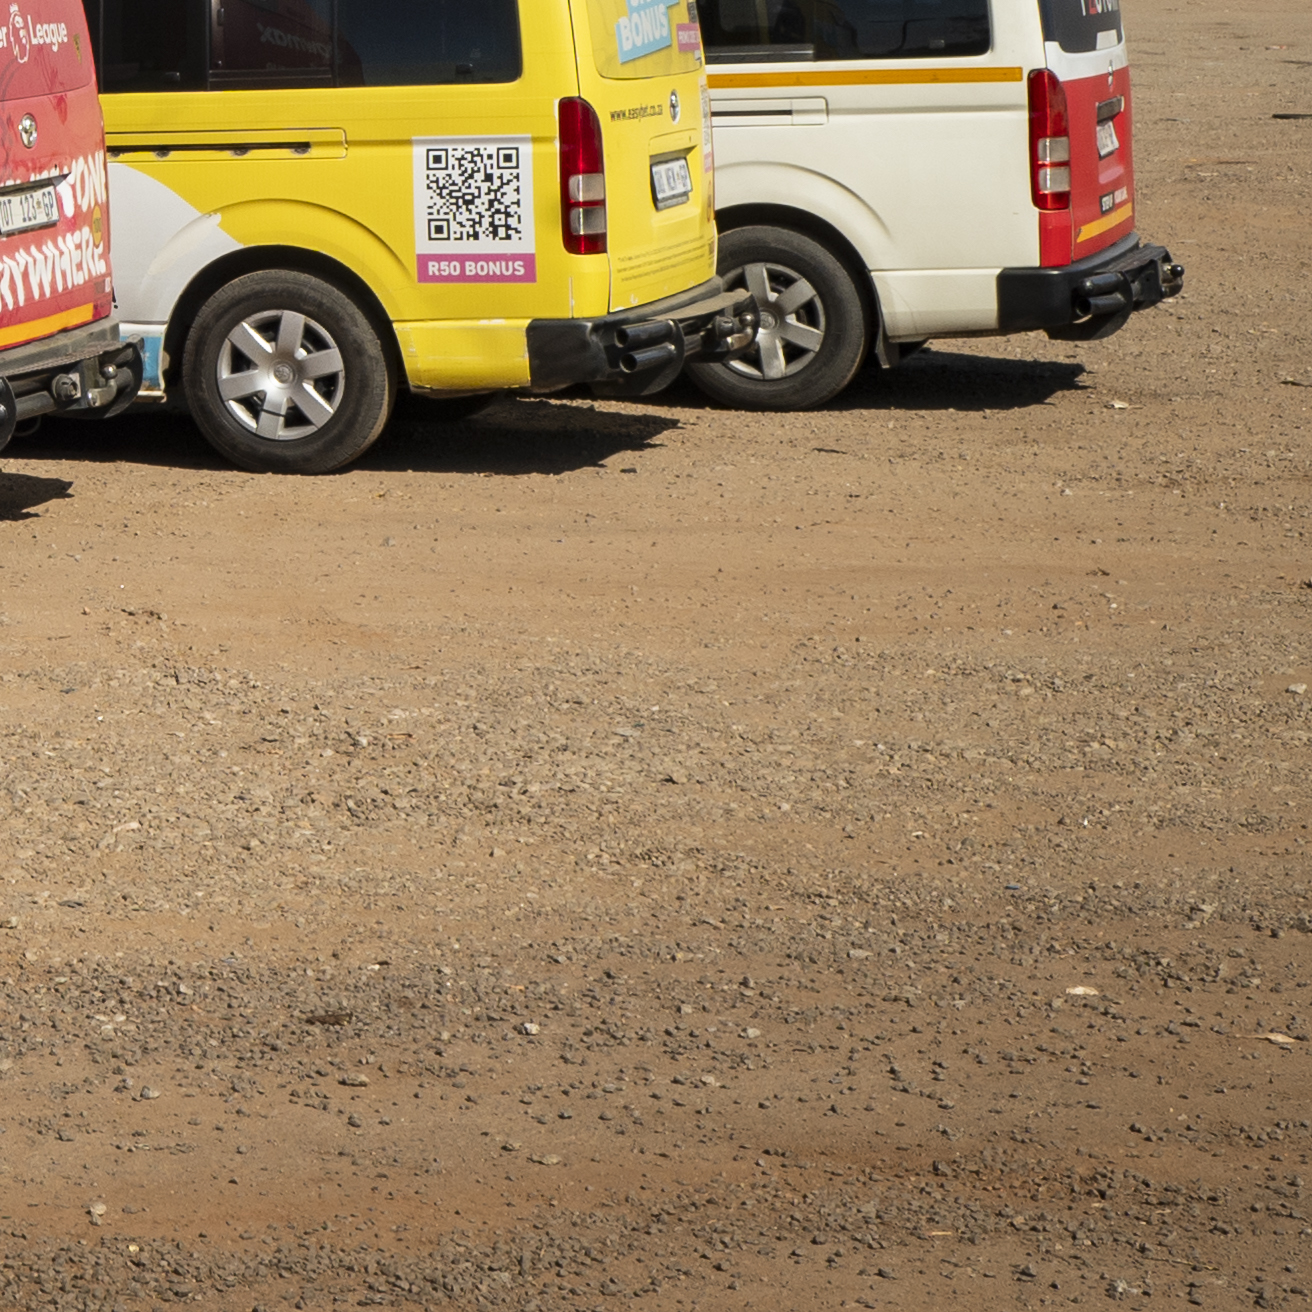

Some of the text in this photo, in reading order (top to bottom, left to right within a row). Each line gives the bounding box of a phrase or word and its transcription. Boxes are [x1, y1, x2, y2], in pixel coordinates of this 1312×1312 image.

[27, 14, 68, 52] League
[618, 3, 668, 51] BONUS
[428, 260, 526, 277] R50 BONUS
